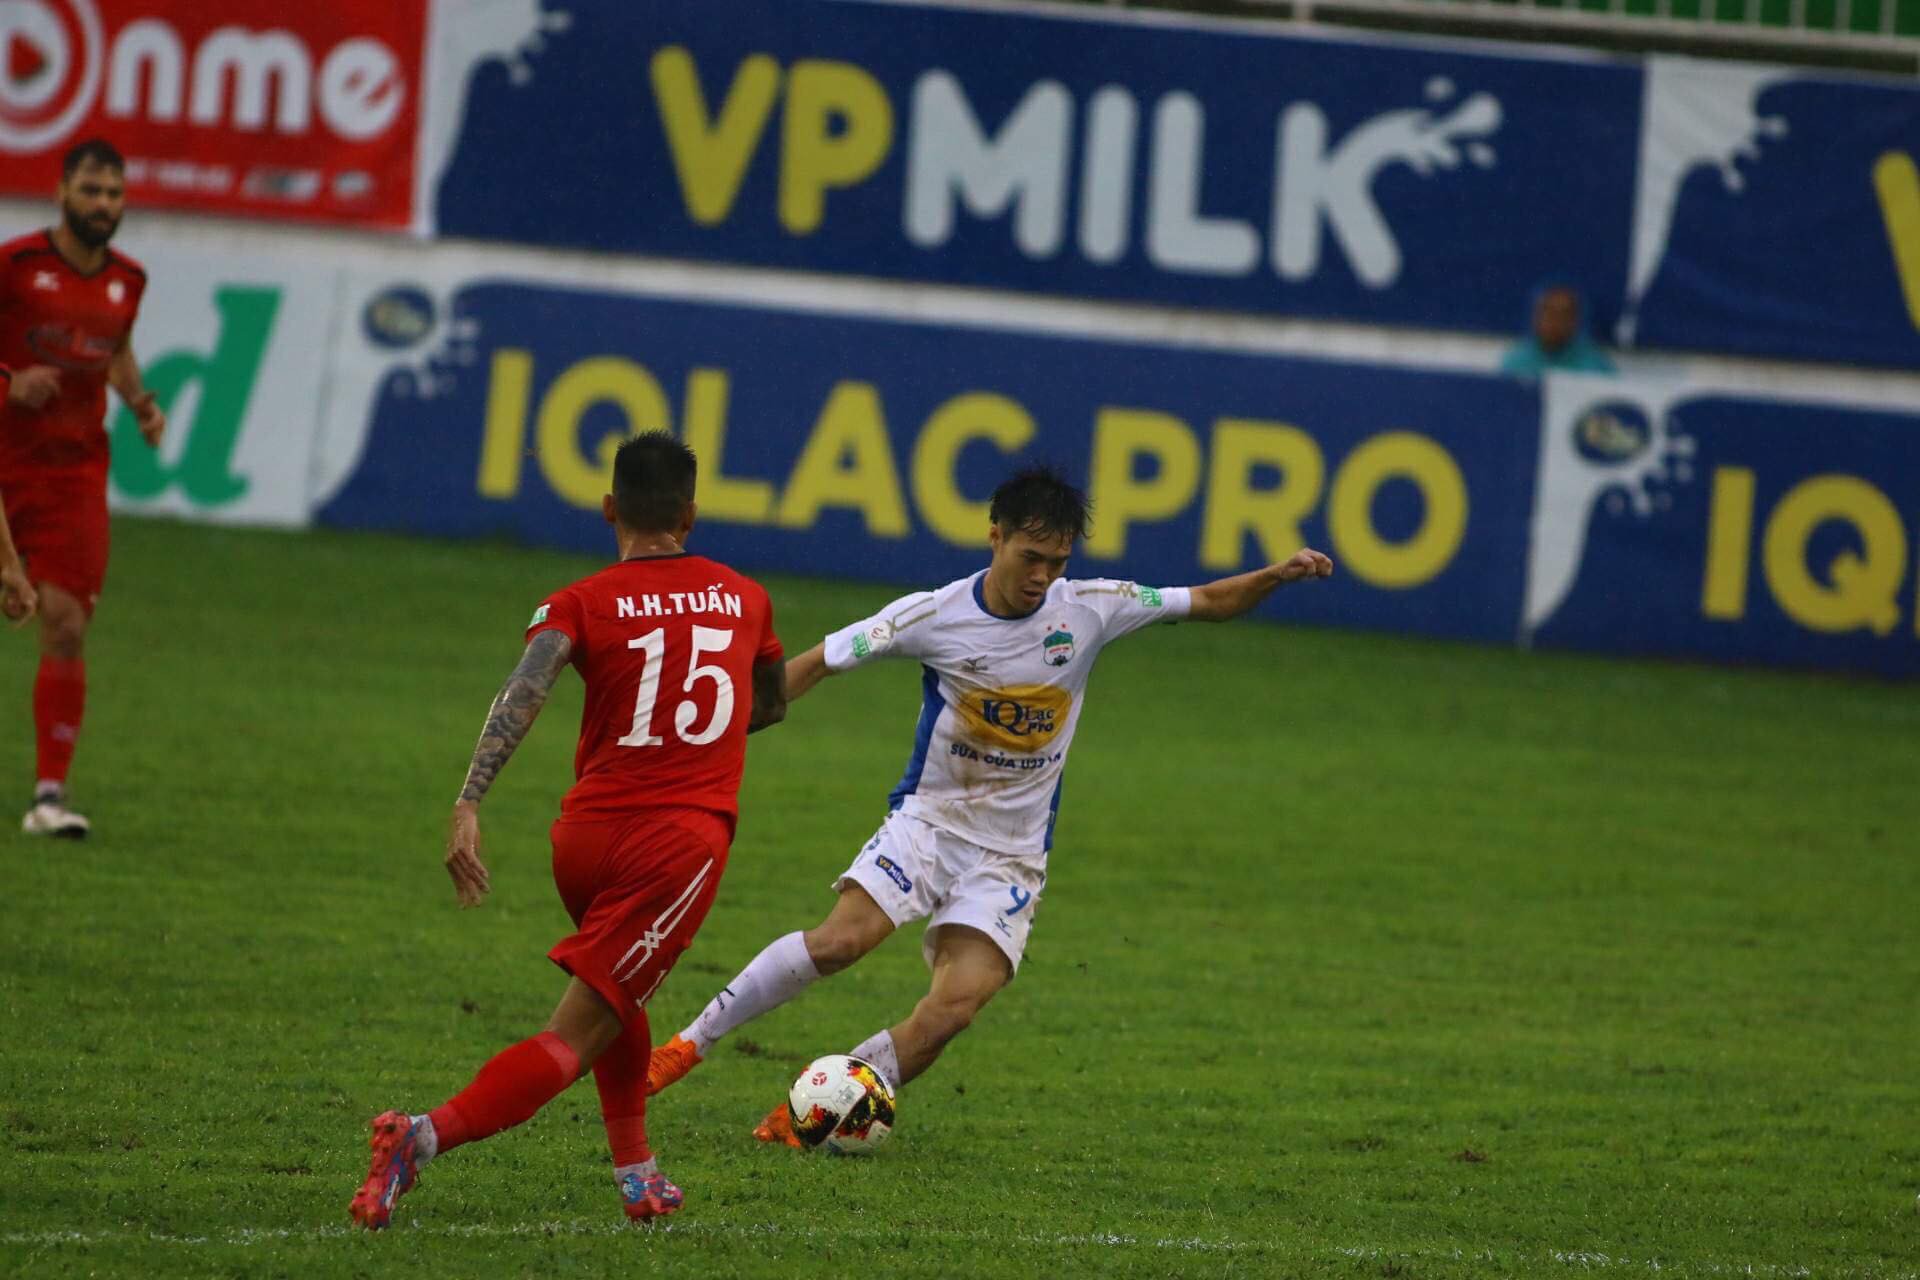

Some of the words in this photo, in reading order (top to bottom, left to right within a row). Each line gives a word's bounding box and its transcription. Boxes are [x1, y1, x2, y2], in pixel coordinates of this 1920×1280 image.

[651, 46, 1502, 287] VPMILK
[477, 349, 1037, 548] IQLAC
[1084, 407, 1468, 589] PRO
[616, 583, 742, 618] N.H.TUẤN
[1702, 466, 1920, 636] IQ
[616, 624, 735, 747] 15
[982, 699, 1031, 736] IQ
